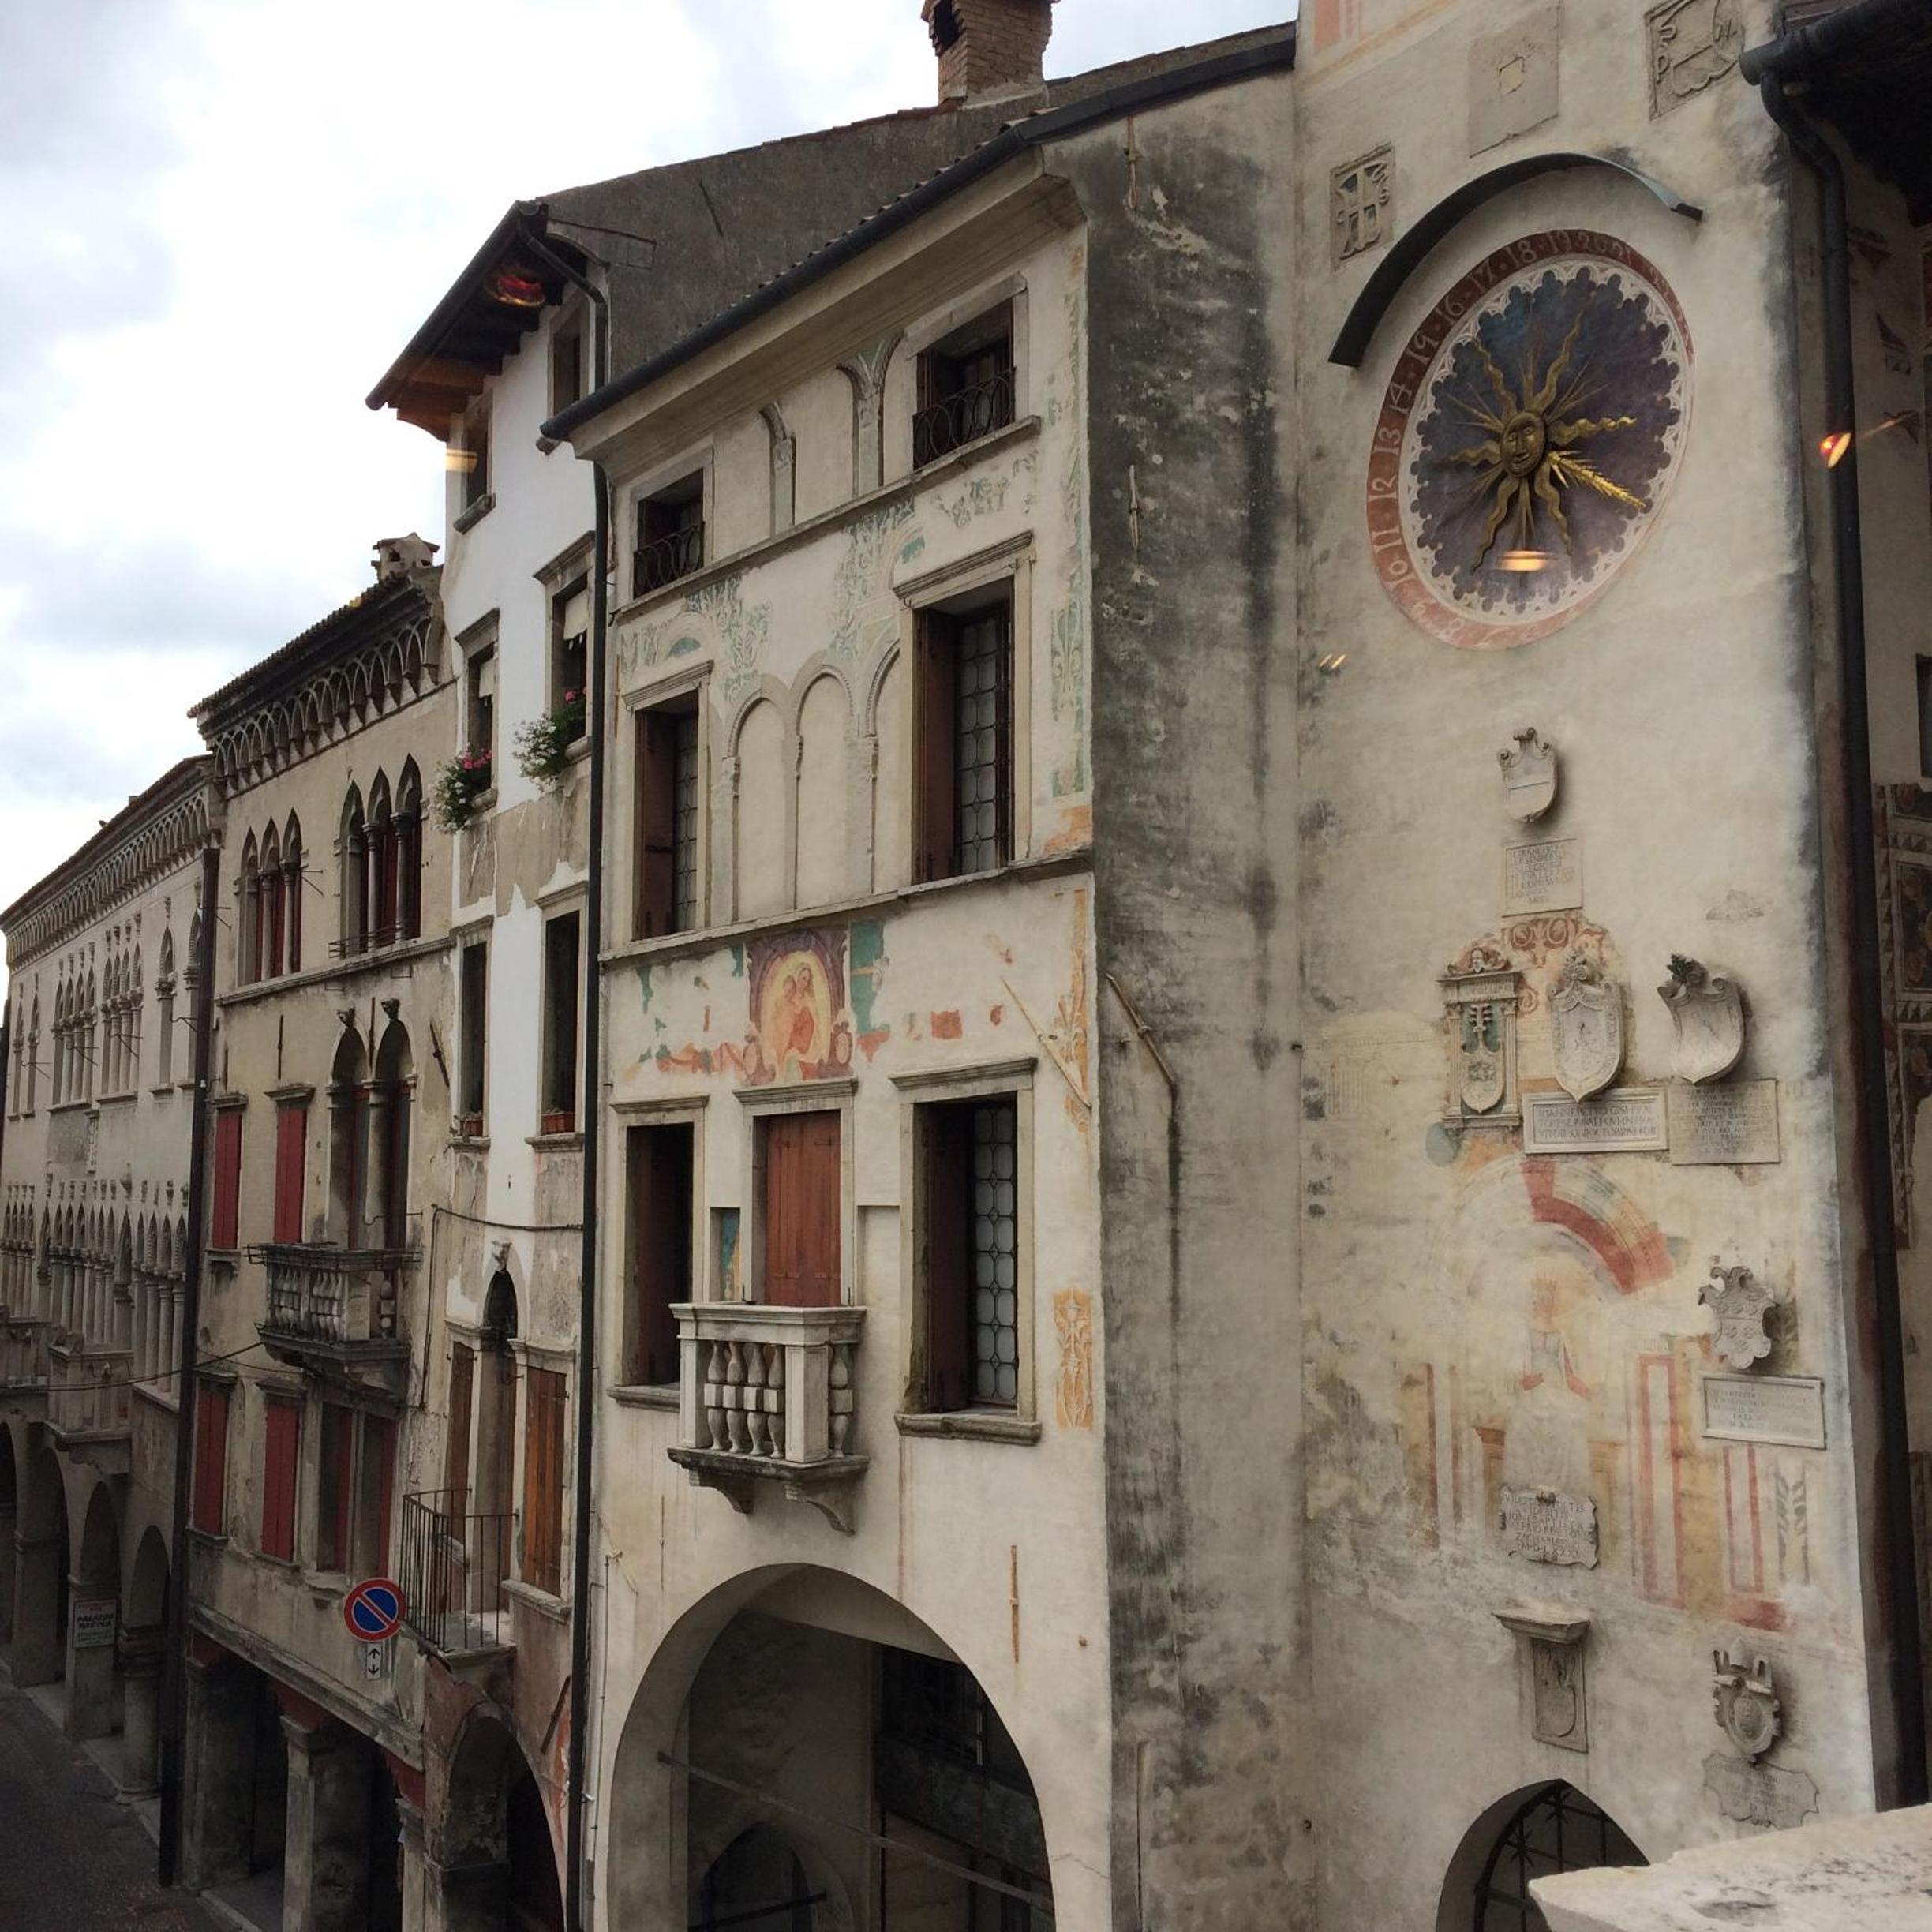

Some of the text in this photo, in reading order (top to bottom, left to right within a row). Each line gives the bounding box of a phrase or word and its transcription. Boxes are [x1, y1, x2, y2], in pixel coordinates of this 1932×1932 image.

[1505, 239, 1538, 270] 18
[1468, 257, 1496, 293] 17
[1435, 294, 1465, 325] 16
[1389, 381, 1413, 414] 14
[1373, 427, 1402, 455] 13
[1368, 475, 1398, 503] 12
[1372, 525, 1402, 553] 11
[1384, 560, 1417, 588] 10
